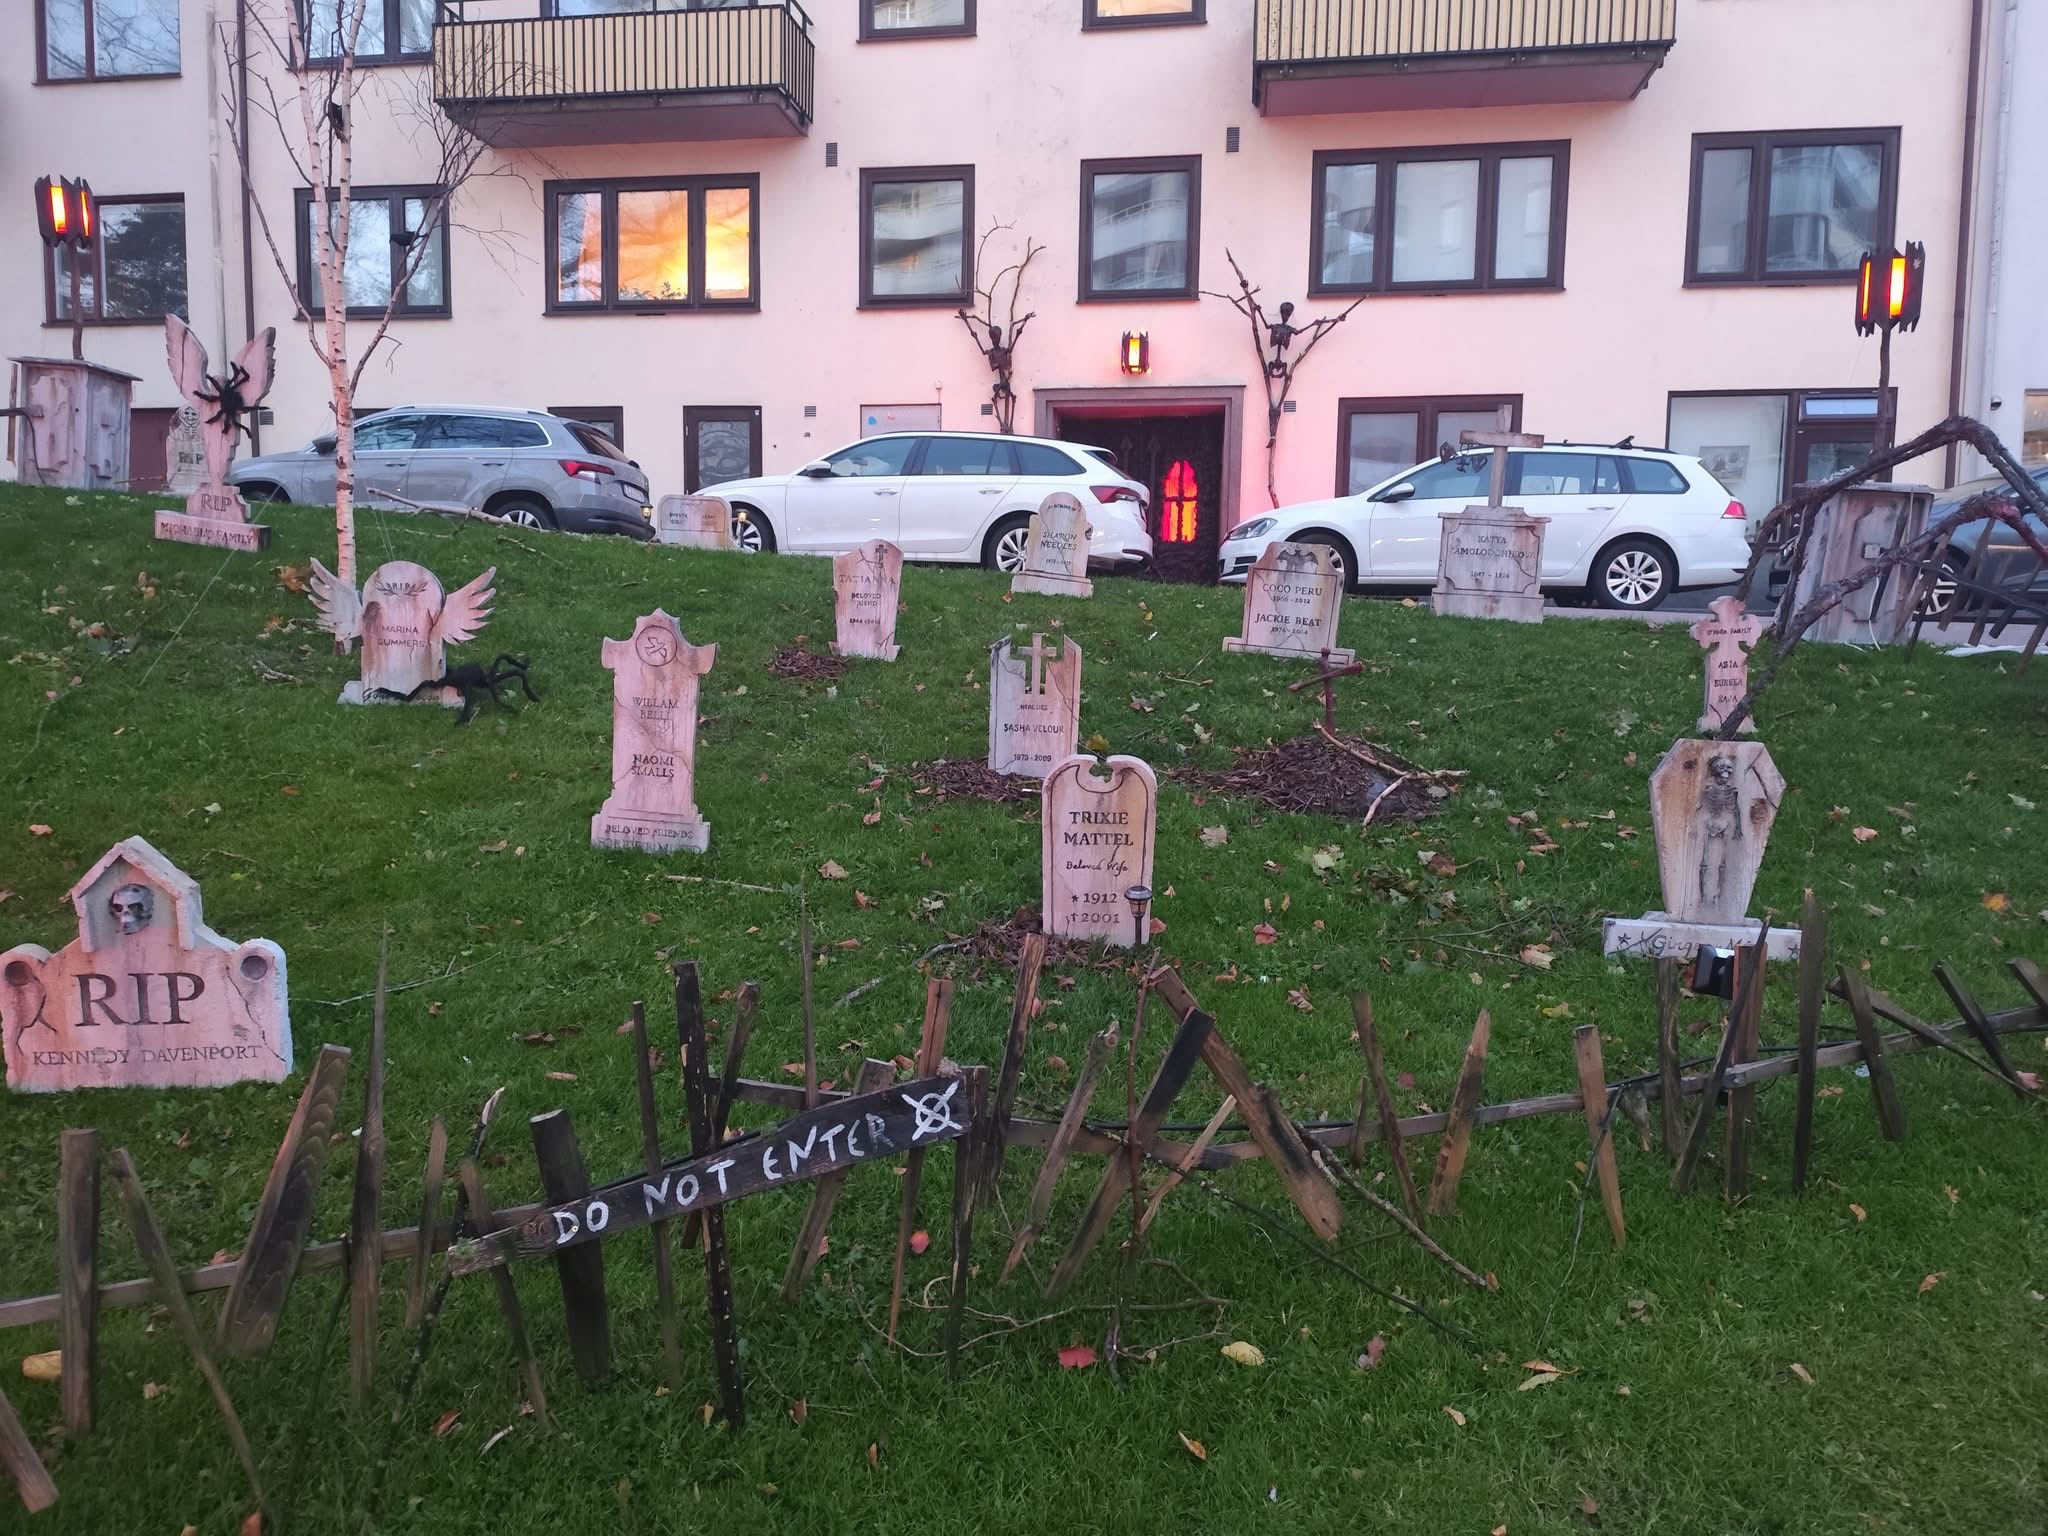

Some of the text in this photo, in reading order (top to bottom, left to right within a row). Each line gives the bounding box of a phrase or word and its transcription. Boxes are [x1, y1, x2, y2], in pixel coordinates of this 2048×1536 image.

[201, 493, 232, 512] RIP
[1040, 541, 1077, 551] NEEDLES
[1478, 535, 1507, 545] KATYA
[851, 592, 882, 600] BELOVED
[1263, 583, 1322, 596] COCO PERU
[1255, 613, 1321, 626] JACKIE BEAT
[382, 624, 419, 634] MARINA
[1718, 661, 1739, 669] ASIA
[1714, 678, 1743, 688] EUREKA
[632, 696, 678, 709] WILLAM
[1004, 723, 1064, 734] SASHA VELOUR
[633, 753, 674, 767] NAOMI
[631, 766, 674, 778] SMALLS
[1069, 812, 1128, 825] TRIXIE
[605, 824, 695, 840] BELOVED FRIENDS
[1064, 832, 1133, 846] MATTEL
[1066, 859, 1103, 870] Beloved
[1083, 893, 1118, 904] 1912
[72, 972, 205, 1027] RIP
[141, 1045, 263, 1063] DAVENPORT
[552, 1112, 896, 1245] DO NOT ENTER
